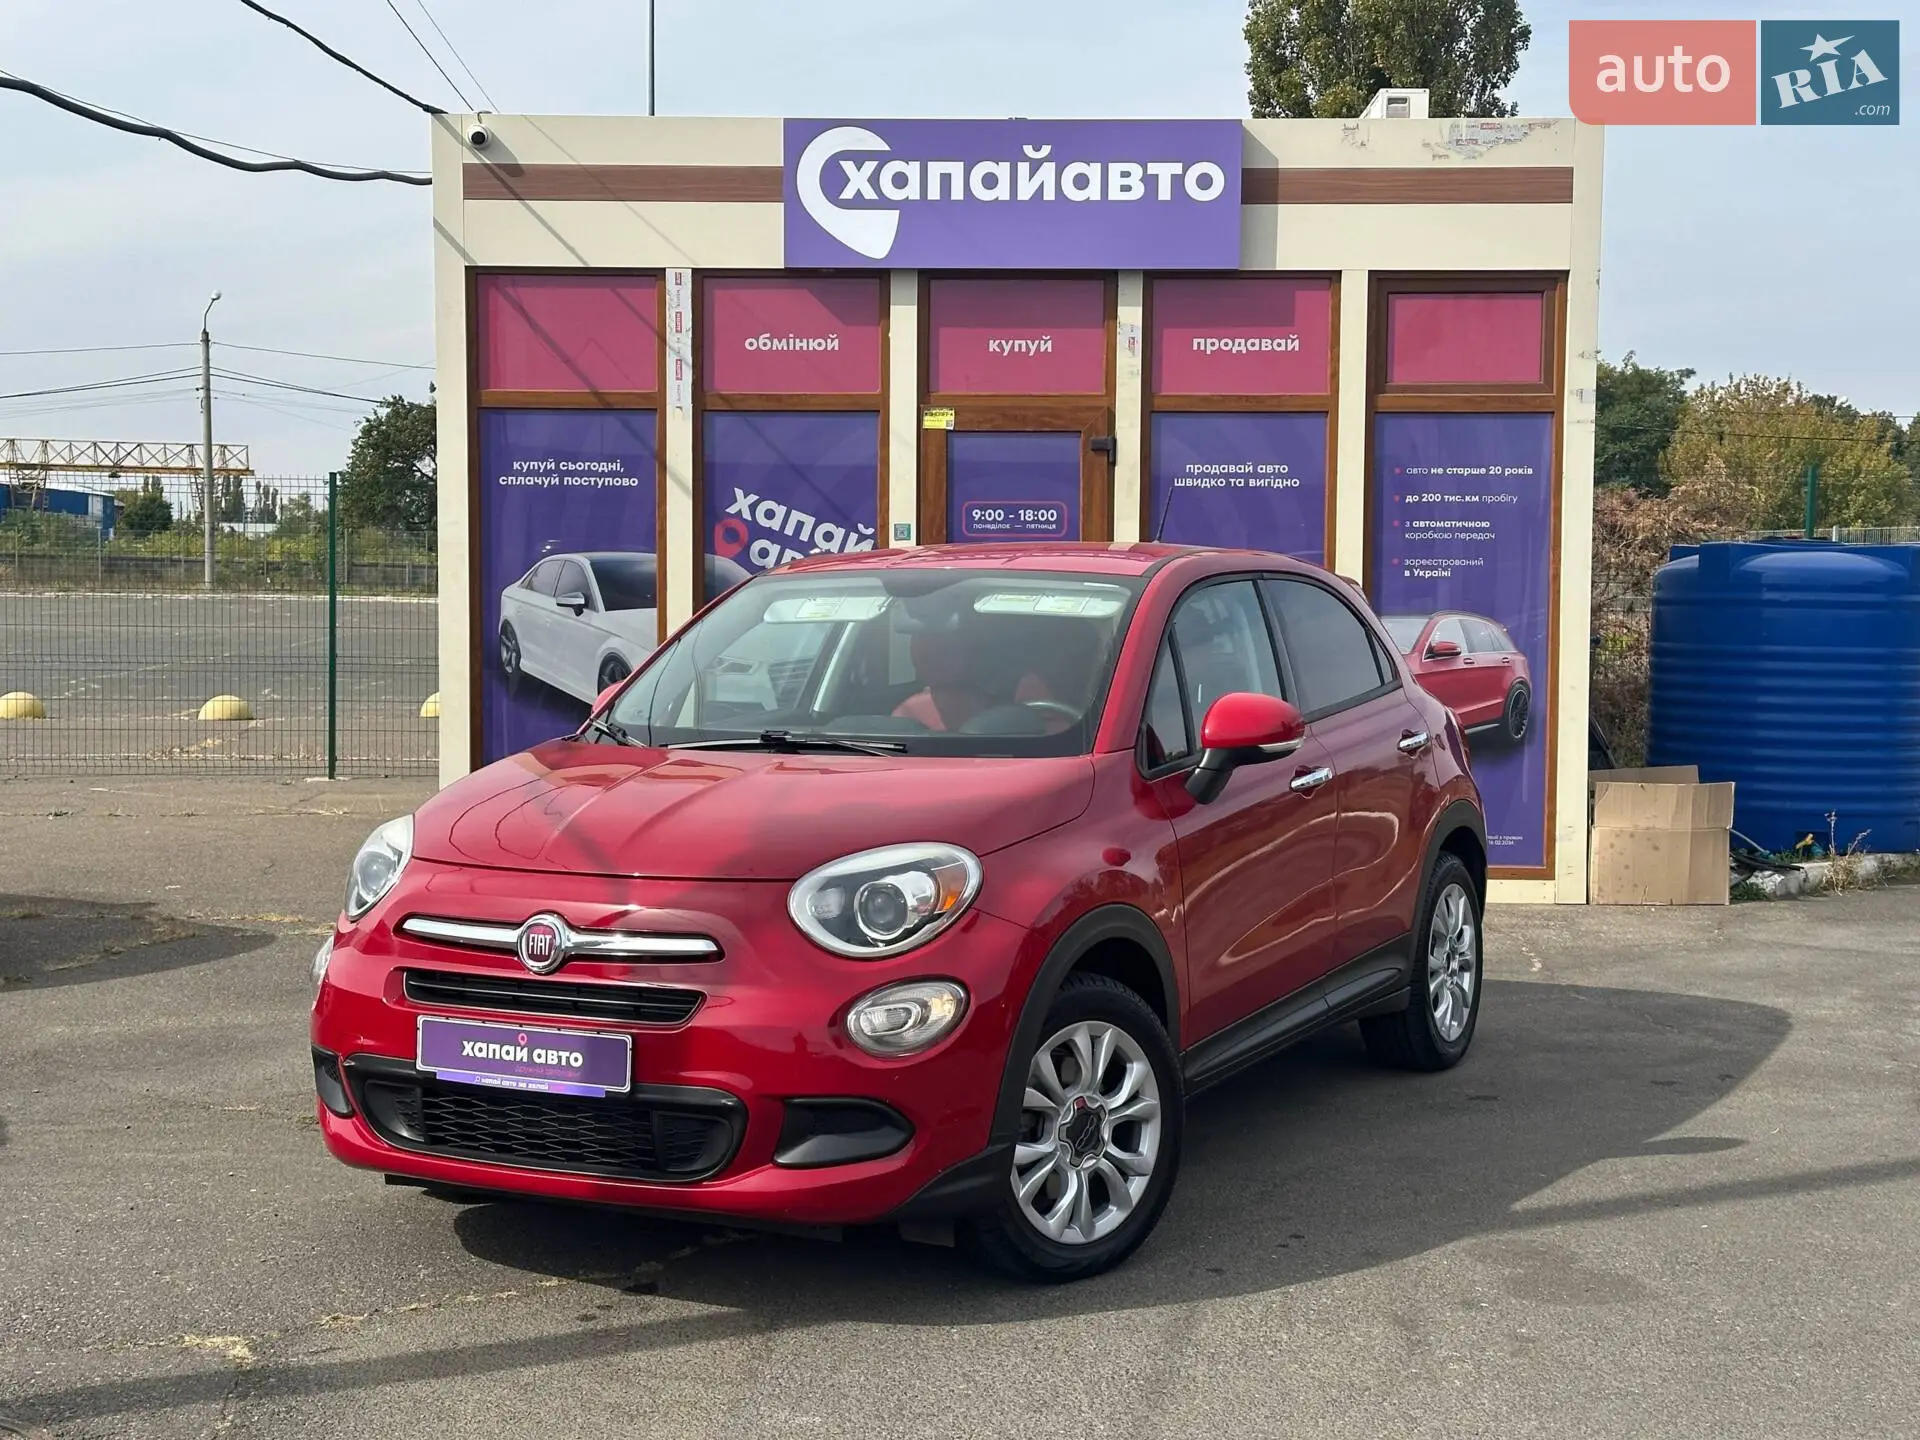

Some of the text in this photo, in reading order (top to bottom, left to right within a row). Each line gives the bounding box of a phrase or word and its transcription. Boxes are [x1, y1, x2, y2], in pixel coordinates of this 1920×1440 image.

[744, 333, 840, 351] обмінюй
[989, 335, 1052, 356] купуй
[1192, 334, 1299, 354] продавай
[513, 459, 624, 473] купуй сьогодні,
[1185, 462, 1289, 475] продавай авто
[1406, 466, 1533, 477] авто не старше 20 років
[499, 474, 639, 488] сплачуй поступово
[1174, 476, 1300, 488] швидко та вигідно
[1405, 495, 1419, 503] до
[1421, 493, 1441, 502] 200
[1482, 493, 1518, 504] пробігу
[725, 487, 875, 553] хапай
[972, 509, 1004, 521] 9:00
[1018, 509, 1057, 521] 18:00
[1412, 520, 1490, 528] автоматичною
[1405, 530, 1495, 540] коробкою передач
[1413, 568, 1451, 579] Україні
[528, 933, 553, 956] FIAT
[532, 1048, 584, 1068] авто
